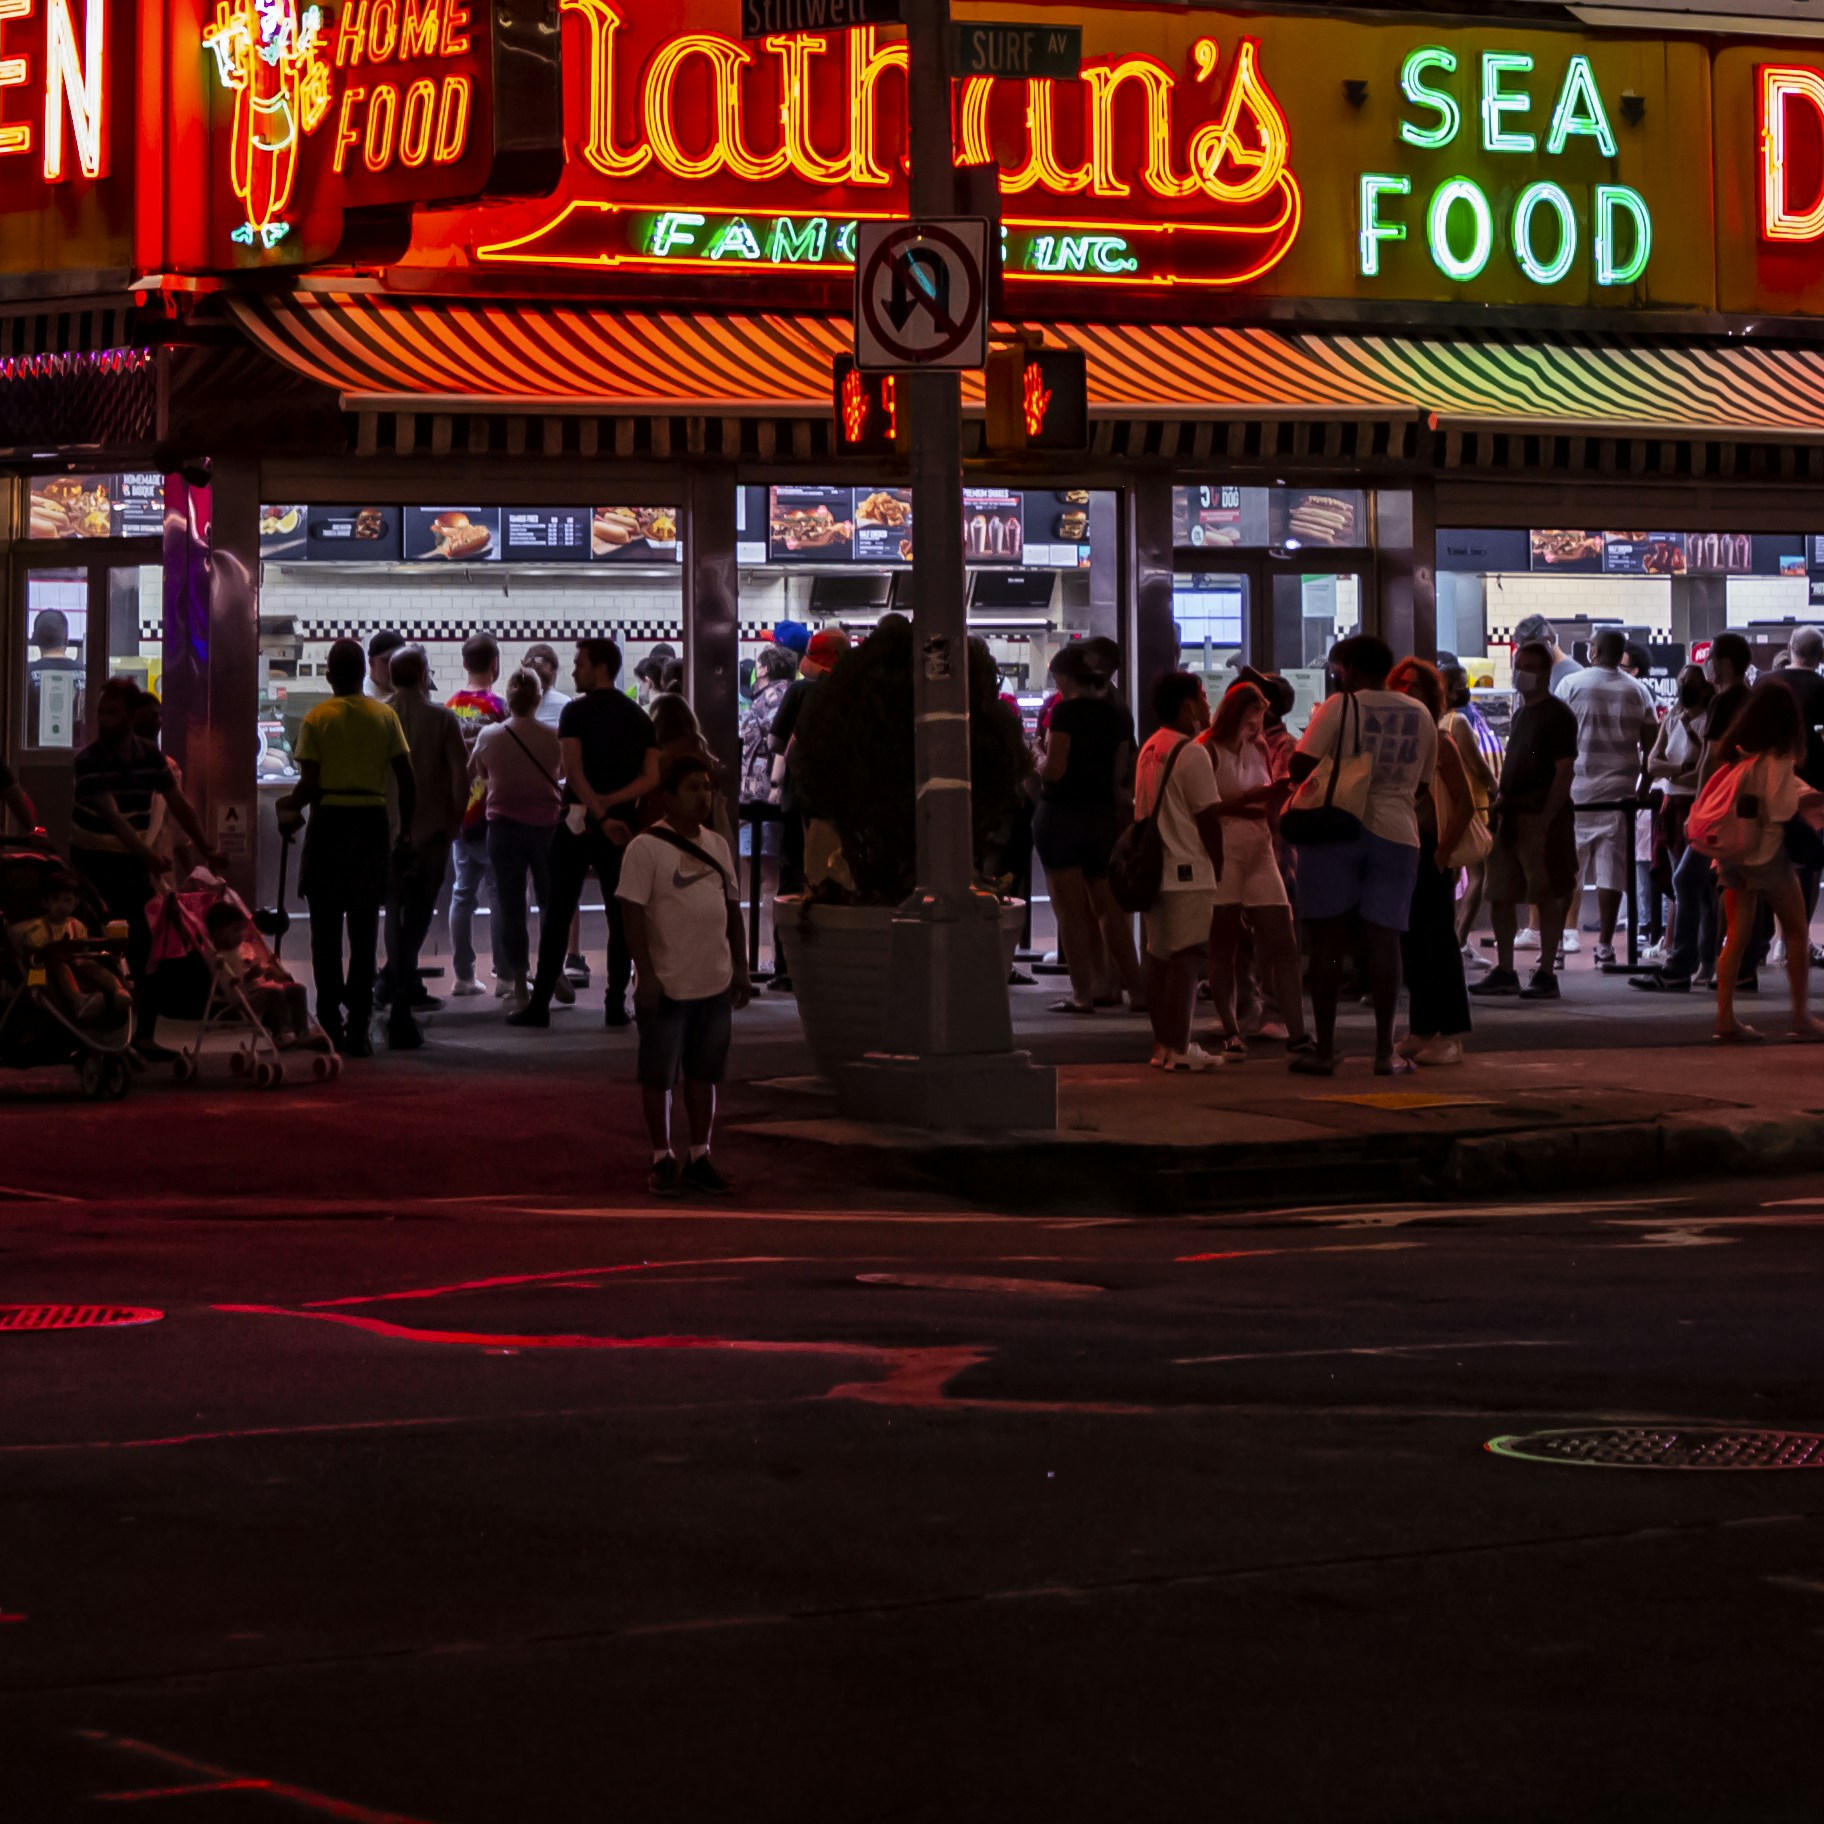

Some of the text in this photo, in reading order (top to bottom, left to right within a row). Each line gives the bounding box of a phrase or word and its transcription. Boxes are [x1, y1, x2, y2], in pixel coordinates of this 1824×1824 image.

[972, 30, 1068, 74] SURF AV
[1399, 43, 1619, 159] SEA
[332, 75, 472, 175] FOOD
[1033, 235, 1139, 274] INC.
[1358, 173, 1653, 286] FOOD
